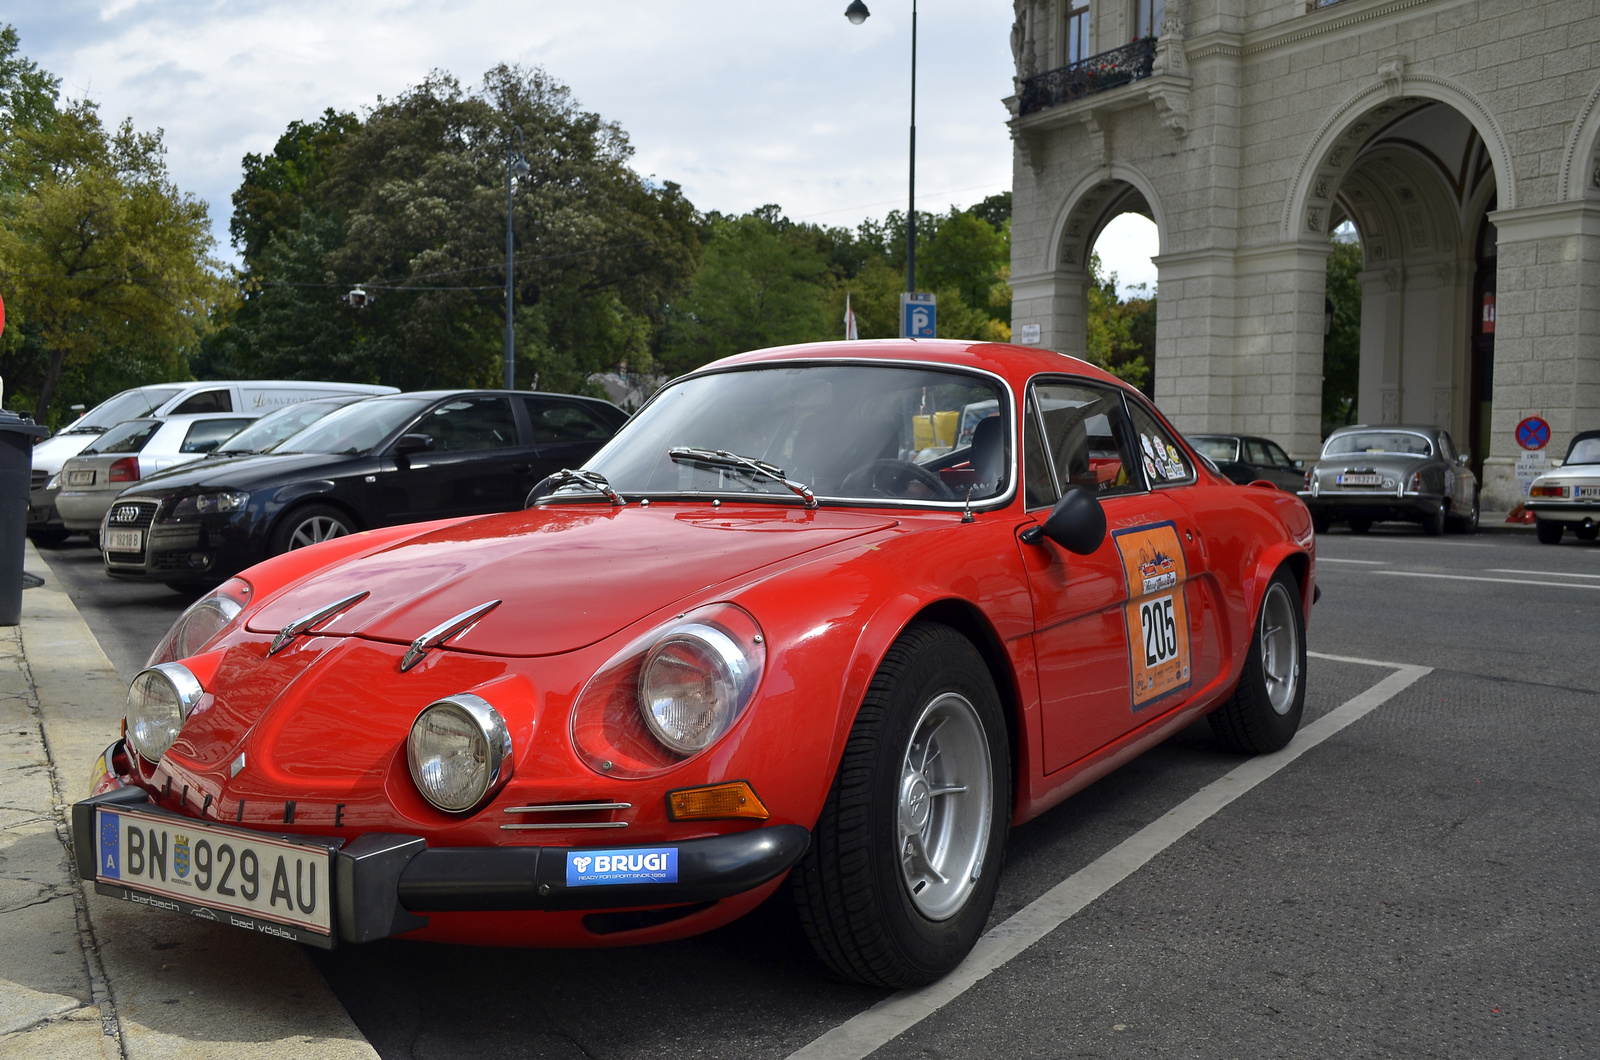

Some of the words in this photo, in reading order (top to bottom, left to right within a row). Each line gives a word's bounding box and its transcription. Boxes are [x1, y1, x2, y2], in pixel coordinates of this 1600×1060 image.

[912, 313, 929, 335] P
[1580, 488, 1592, 496] WU
[134, 534, 138, 546] B
[1142, 598, 1177, 667] 205
[106, 854, 116, 870] A
[127, 825, 168, 882] BN
[194, 838, 260, 902] 929
[270, 855, 316, 915] AU
[594, 854, 667, 873] BRUGI
[230, 915, 255, 930] bad
[257, 924, 297, 941] vöslau
